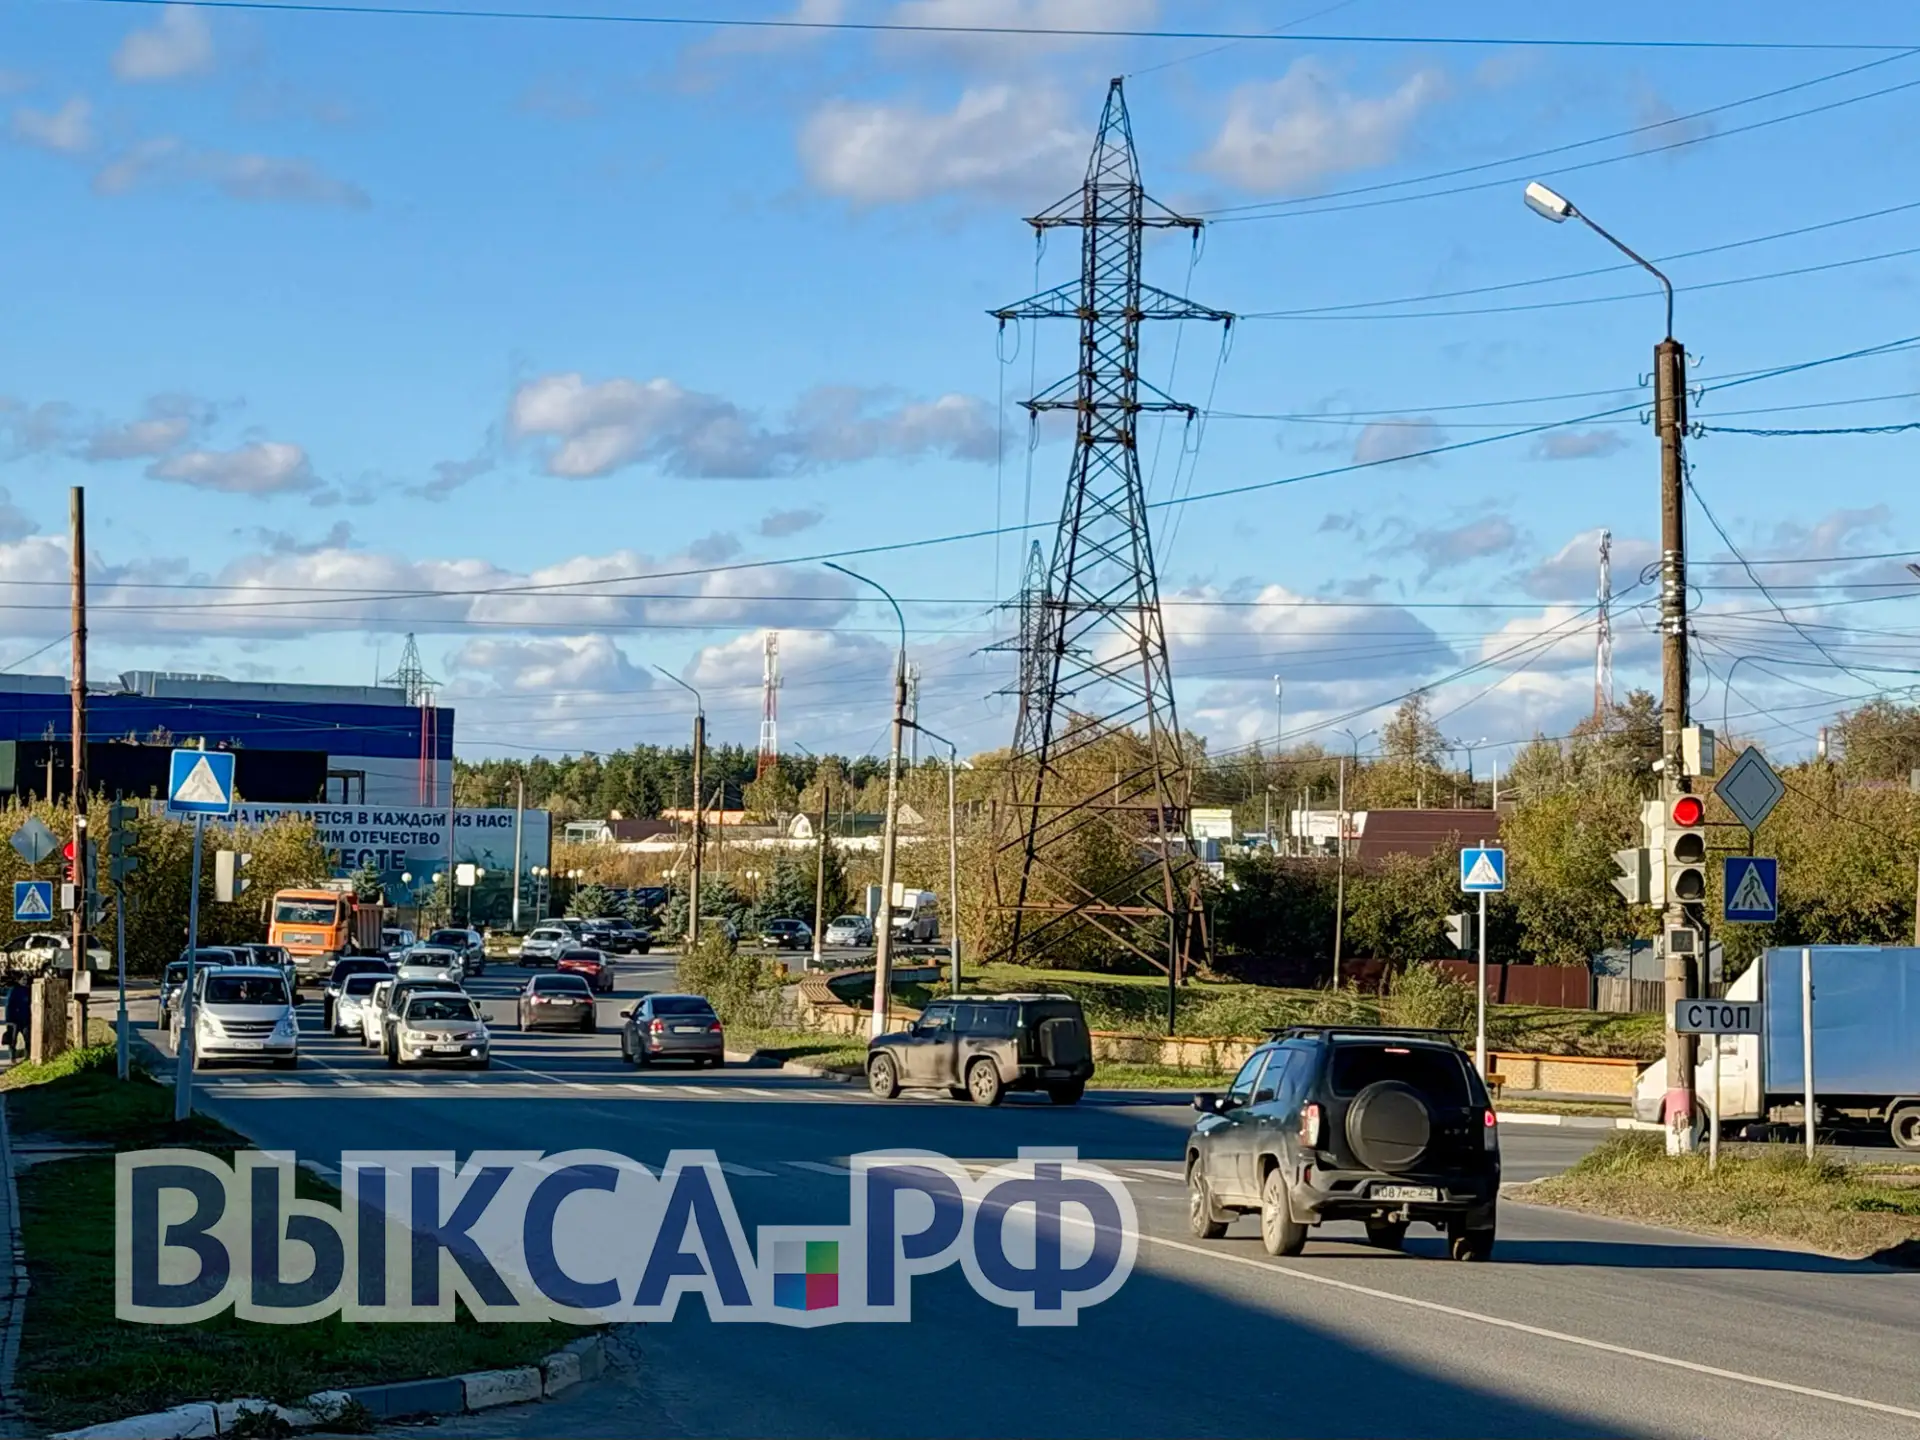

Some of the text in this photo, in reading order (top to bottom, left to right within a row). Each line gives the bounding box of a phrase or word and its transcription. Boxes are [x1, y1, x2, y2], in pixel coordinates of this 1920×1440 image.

[357, 812, 368, 825] В
[373, 812, 446, 828] КАЖДОМ
[453, 813, 471, 827] ИЗ
[476, 814, 513, 828] НАС!
[349, 830, 441, 845] ОТЕЧЕСТВО
[1688, 1005, 1750, 1029] СТОП
